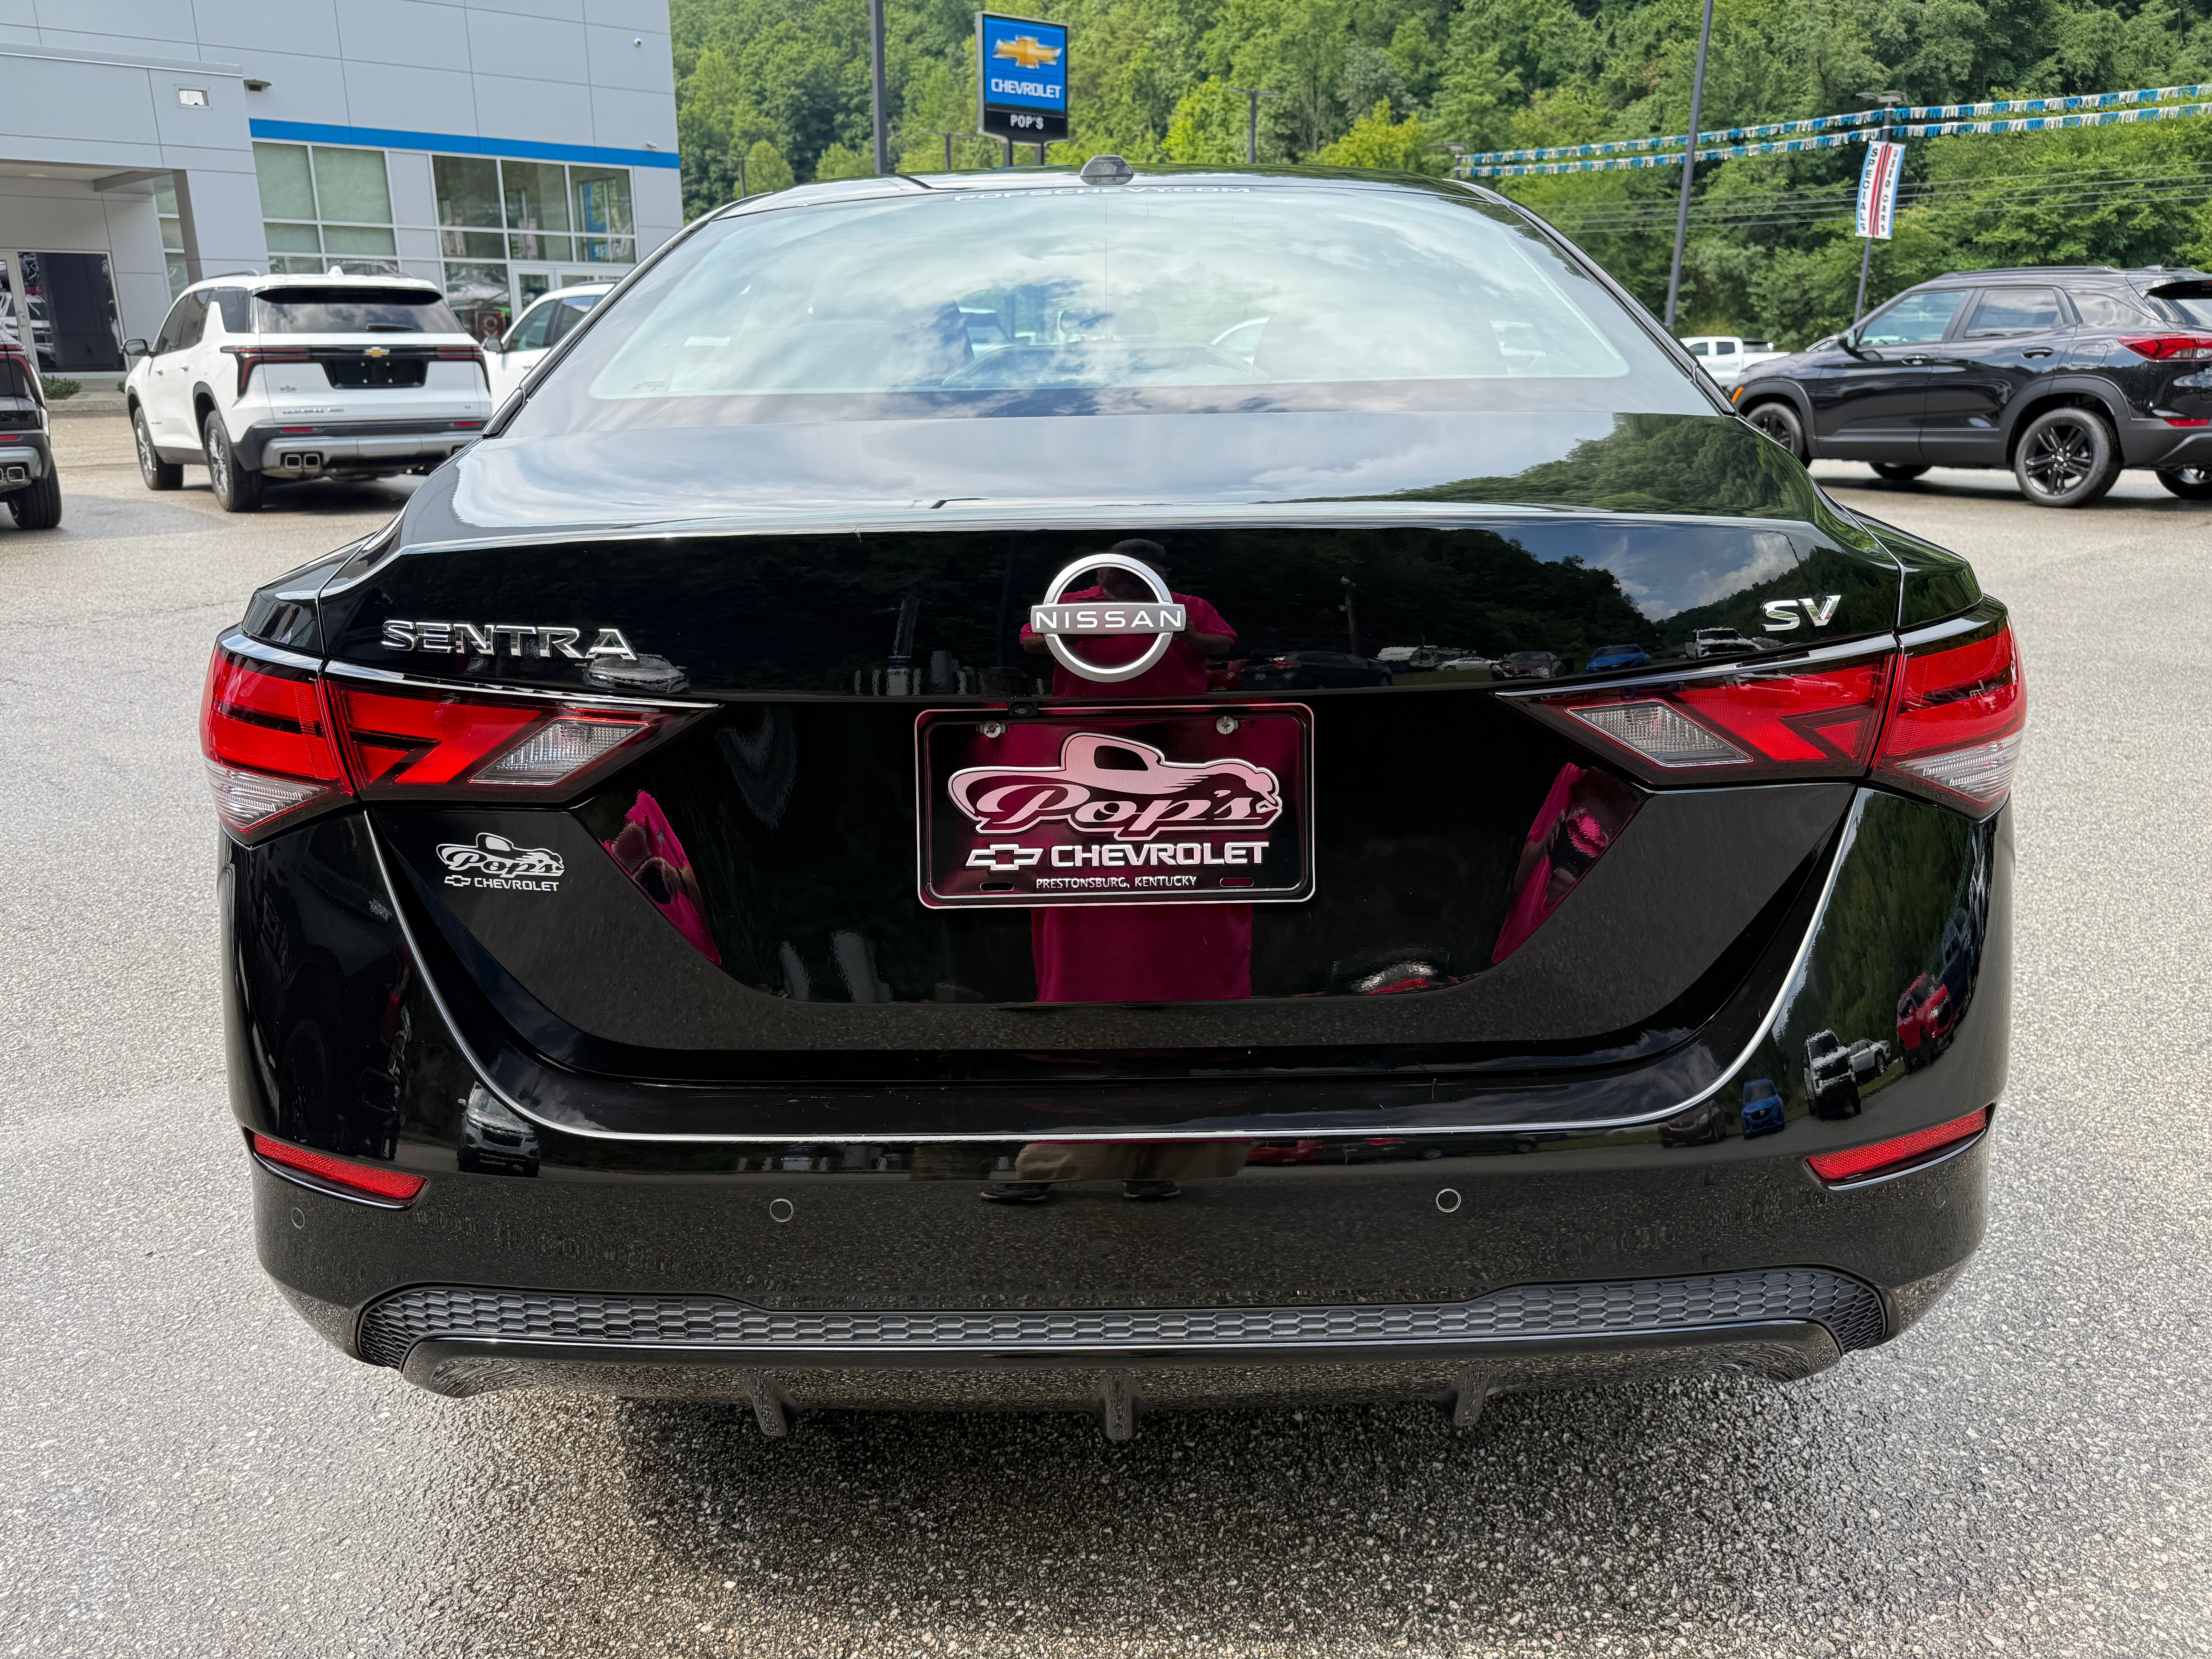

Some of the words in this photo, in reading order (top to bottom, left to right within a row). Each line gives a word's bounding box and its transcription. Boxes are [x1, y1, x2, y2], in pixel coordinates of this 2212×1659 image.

[991, 79, 1061, 98] CHEVROLET
[1010, 114, 1044, 130] POP'S
[954, 187, 1250, 201] POPSCHEVY.COM
[1860, 148, 1878, 231] SPECIALS
[1036, 610, 1181, 629] NISSAN
[1760, 595, 1841, 632] SV
[381, 620, 640, 661] SENTRA
[976, 783, 1263, 831] Pop's
[446, 850, 555, 875] Pop's
[1051, 841, 1269, 867] CHEVROLET
[474, 878, 559, 891] CHEVROLET
[1036, 877, 1130, 889] PRESTONSBURG,
[1134, 876, 1197, 888] KENTUCKY
